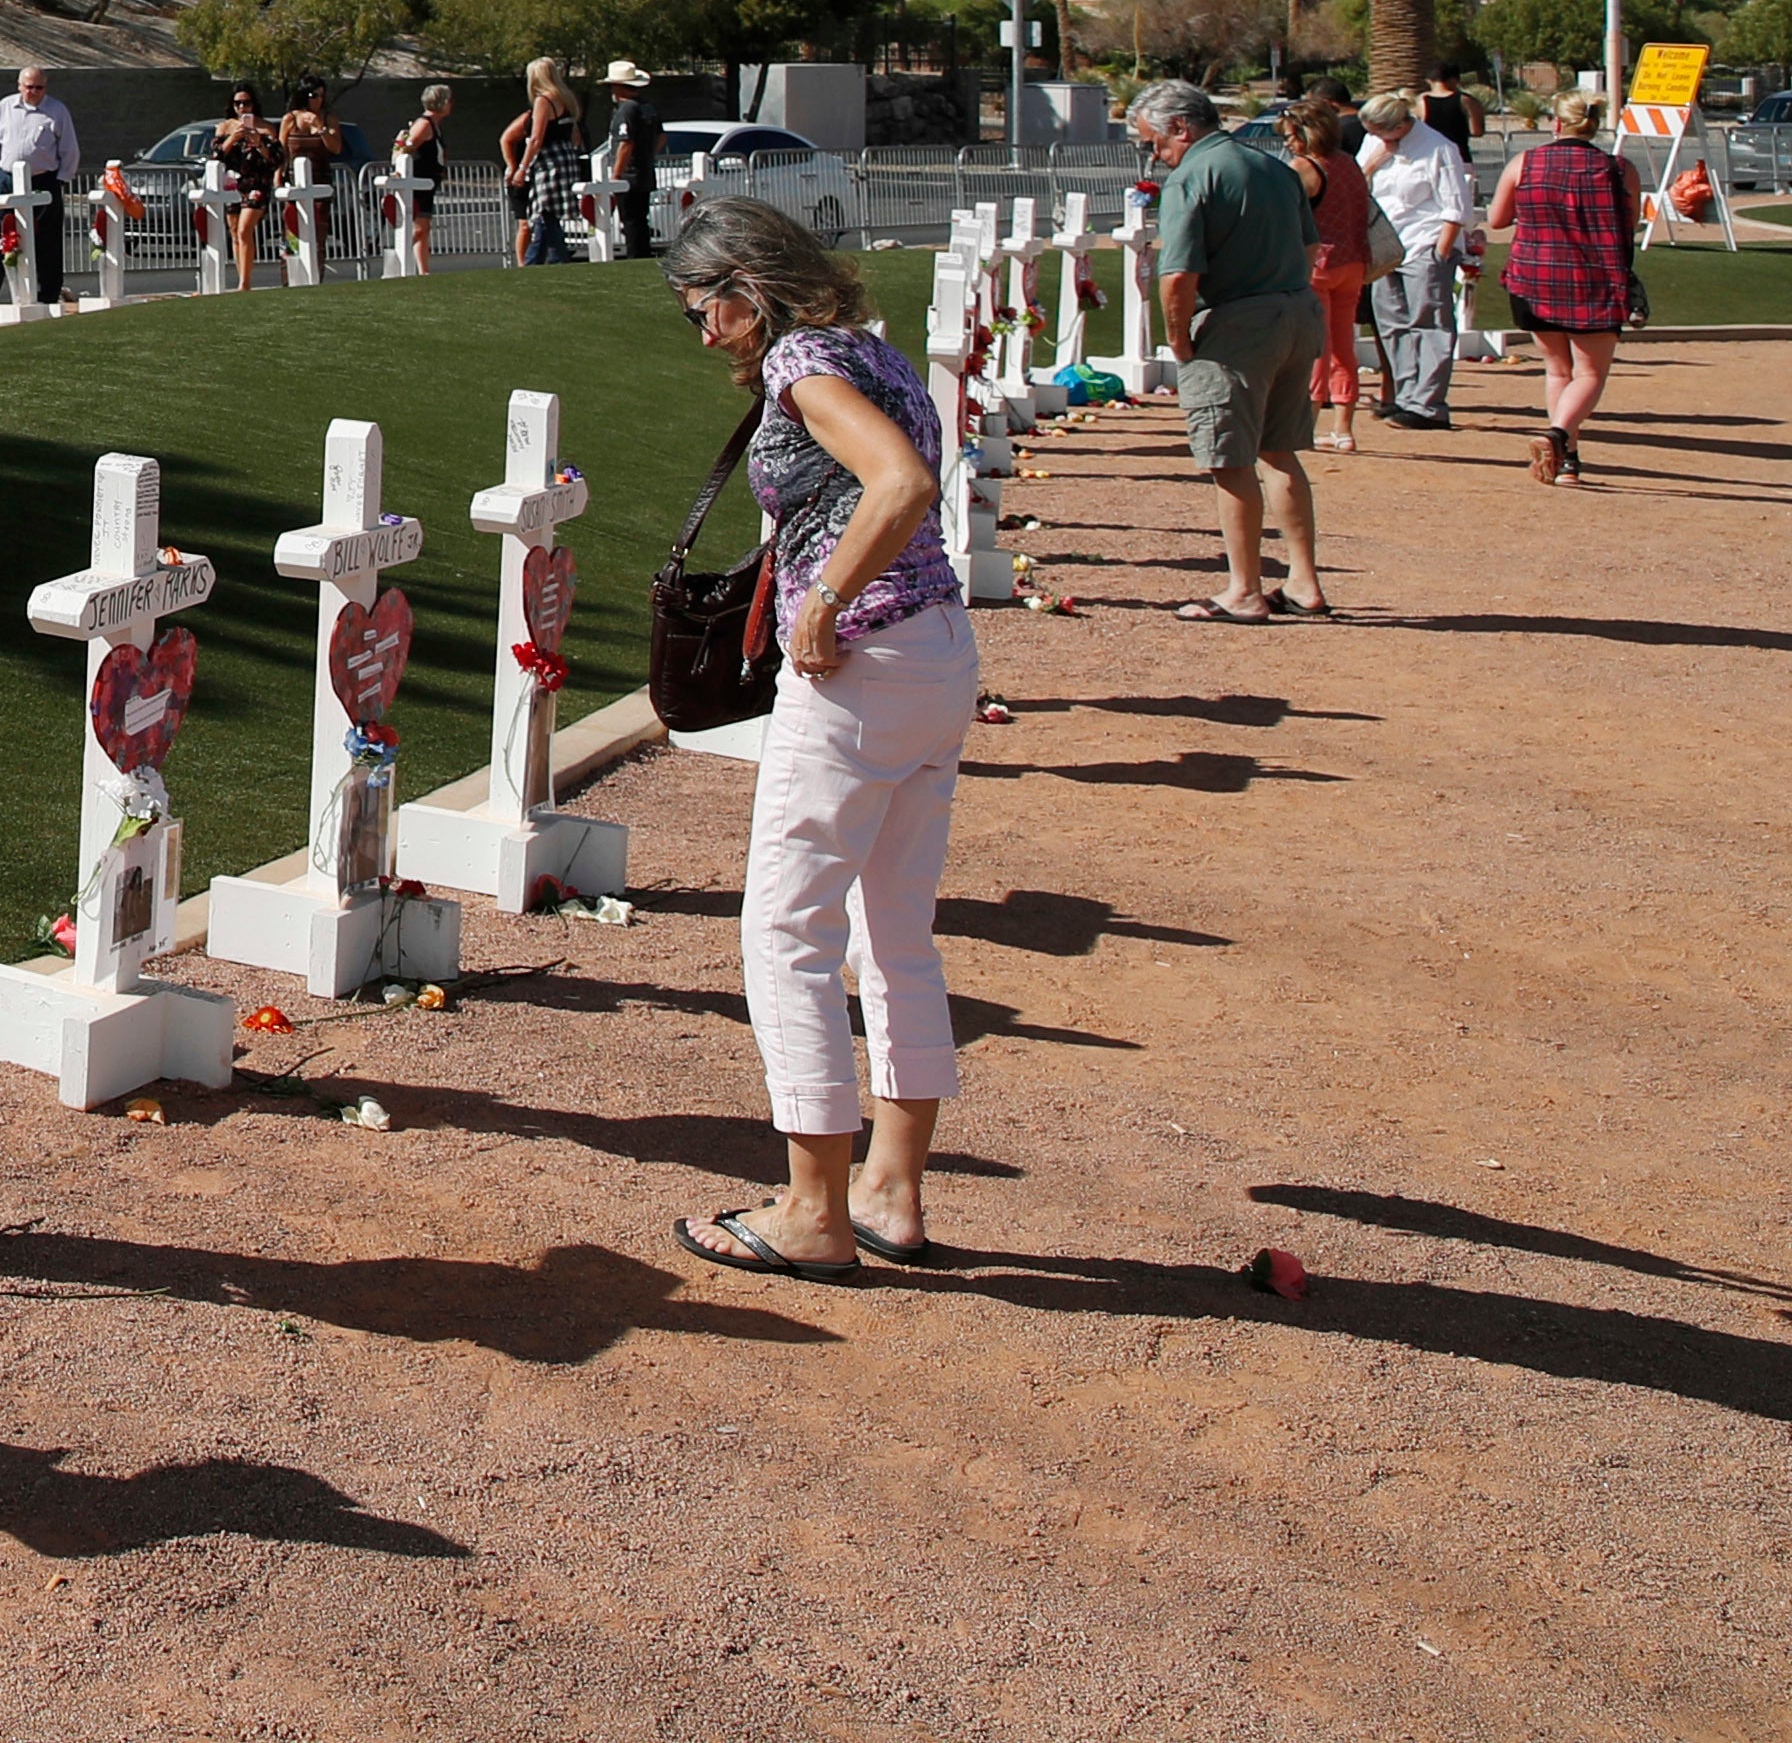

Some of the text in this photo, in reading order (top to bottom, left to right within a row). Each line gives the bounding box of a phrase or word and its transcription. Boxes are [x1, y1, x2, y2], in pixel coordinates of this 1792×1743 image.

[1657, 50, 1690, 60] Welcome
[334, 539, 360, 577] BILL
[89, 562, 210, 631] JENNIFER PARKS
